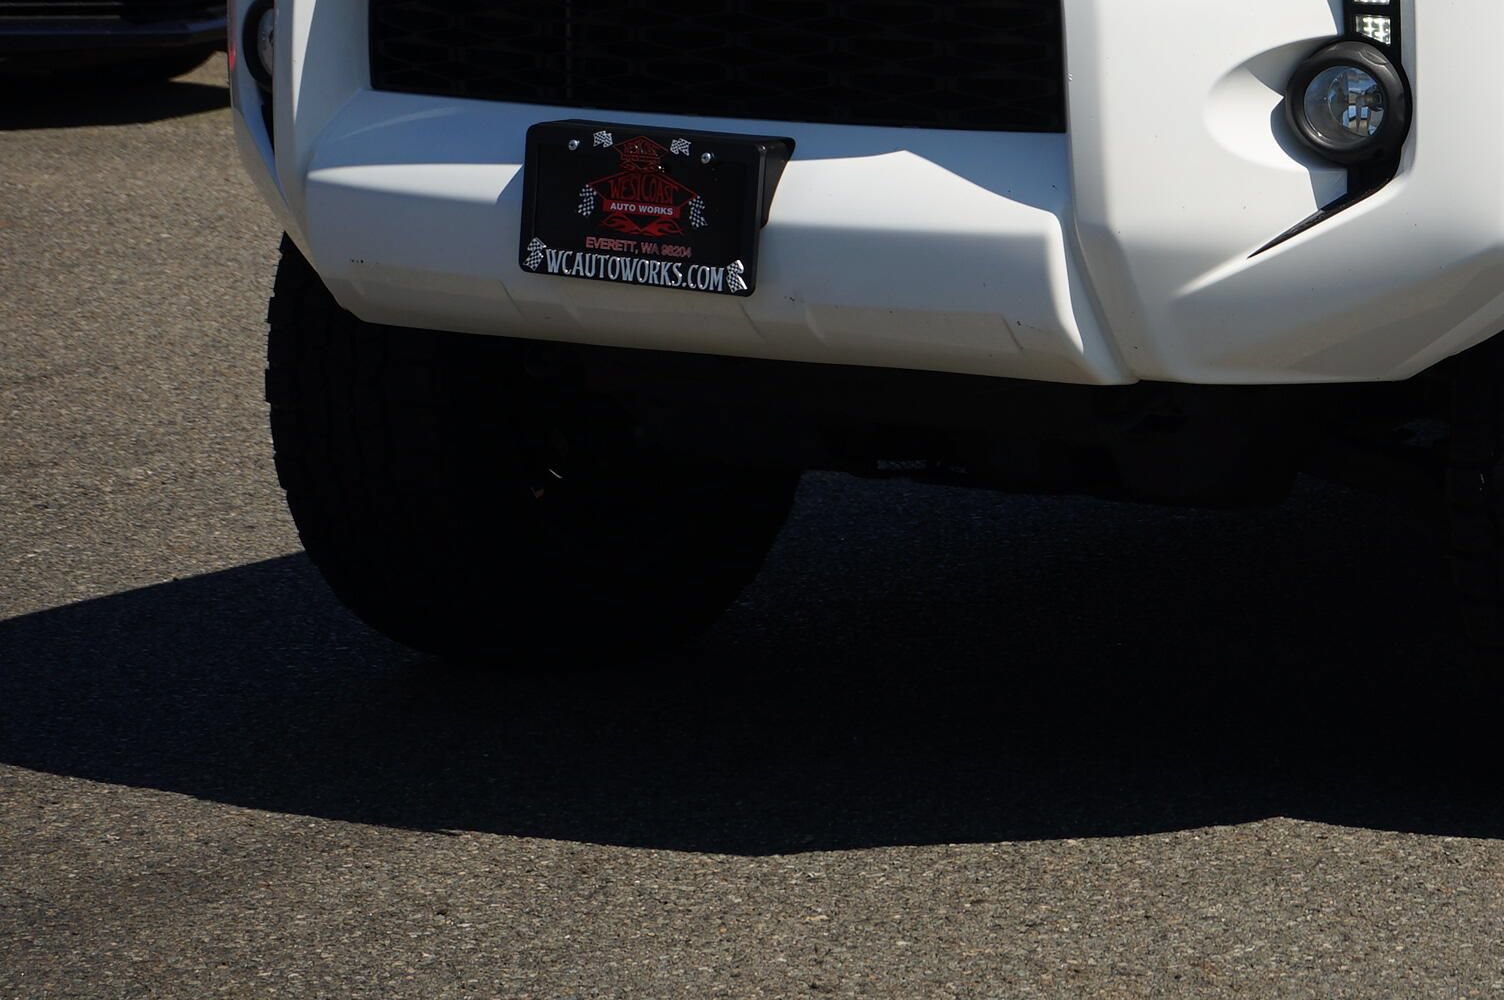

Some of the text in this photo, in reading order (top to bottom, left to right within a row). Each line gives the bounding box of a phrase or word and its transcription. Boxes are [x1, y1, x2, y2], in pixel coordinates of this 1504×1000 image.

[610, 202, 673, 216] AUTO WORKS
[585, 236, 639, 254] EVERETT,
[640, 241, 659, 255] WA
[546, 249, 725, 292] WCAUTOWORKS.COM
